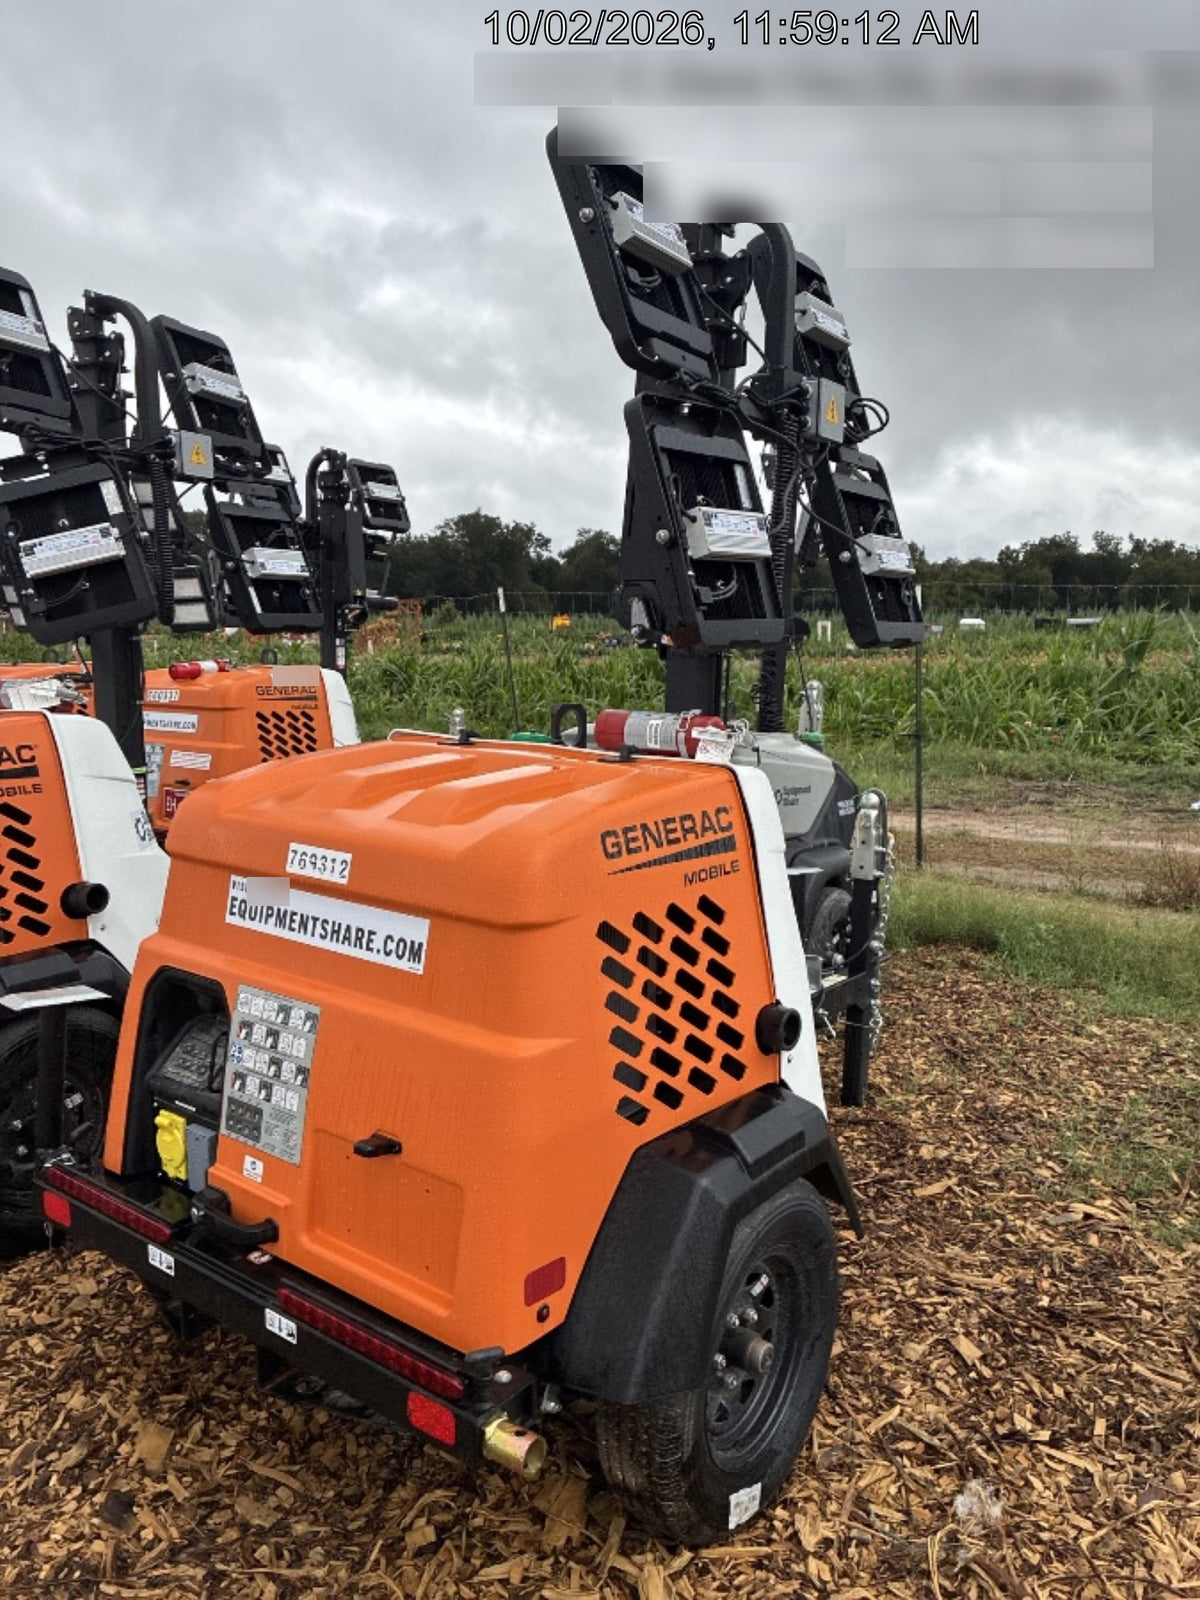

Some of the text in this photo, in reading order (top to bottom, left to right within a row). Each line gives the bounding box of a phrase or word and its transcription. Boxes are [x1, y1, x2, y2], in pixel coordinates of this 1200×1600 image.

[600, 806, 734, 860] GENERAC
[289, 849, 350, 879] 769312
[683, 860, 741, 888] MOBILE
[228, 895, 424, 965] EQUIPMENTSHARE.COM
